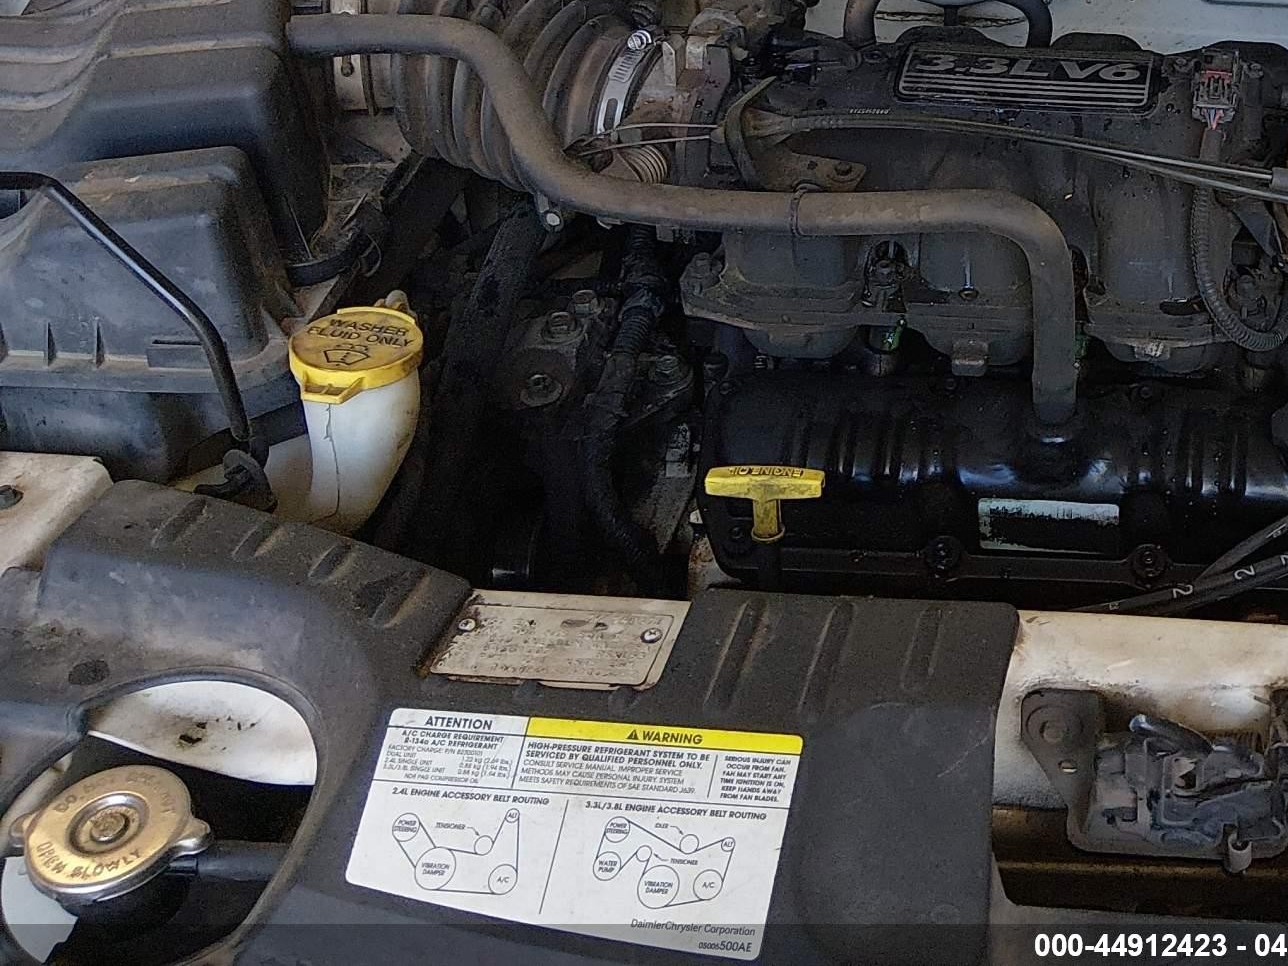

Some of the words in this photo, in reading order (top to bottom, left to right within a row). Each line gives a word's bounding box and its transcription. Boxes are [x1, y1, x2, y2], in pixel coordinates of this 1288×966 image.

[914, 53, 1050, 77] 3.3L
[1060, 60, 1141, 82] V6
[329, 319, 409, 336] WASHER
[307, 326, 360, 340] FLUID
[366, 335, 414, 347] ONLY
[728, 467, 751, 476] OIL
[751, 466, 804, 477] ENGINE
[425, 716, 493, 730] ATTENTION
[404, 737, 428, 745] R-134a
[448, 741, 498, 750] REFRIGERANT
[420, 731, 451, 739] CHARGE
[454, 734, 504, 743] REQUIREMENT
[642, 730, 703, 744] WARNING
[526, 750, 566, 760] SERVICED
[569, 753, 580, 761] BY
[582, 754, 625, 764] QUALIFIED
[628, 757, 678, 767] PERSONNEL
[679, 760, 703, 769] ONLY.
[528, 741, 592, 754] HIGH-PRESSURE
[594, 745, 651, 757] REFRIGERANT
[653, 749, 686, 759] SYSTEM
[688, 752, 698, 760] TO
[700, 753, 710, 761] BE
[521, 768, 553, 776] METHODS
[572, 771, 594, 779] CAUSE
[596, 772, 632, 782] PERSONAL
[659, 777, 684, 785] SYSTEM
[523, 759, 555, 767] CONSULT
[556, 761, 584, 769] SERVICE
[619, 765, 654, 774] IMPROPER
[655, 767, 683, 777] SERVICE
[541, 777, 564, 785] SAFETY
[565, 779, 616, 789] REQUIREMENTS
[642, 784, 678, 793] STANDARD
[738, 786, 760, 794] HANDS
[392, 787, 409, 795] 2.4L
[410, 789, 440, 798] ENGINE
[442, 791, 492, 802] ACCESSORY
[493, 794, 511, 802] BELT
[512, 795, 550, 805] ROUTING
[585, 801, 623, 811] 3.3L/3.8L
[625, 804, 655, 813] ENGINE
[657, 806, 708, 817] ACCESSORY
[729, 811, 767, 821] ROUTING
[702, 881, 716, 889] A/C
[630, 919, 702, 933] DaimlerChrysler
[704, 924, 756, 937] Corporation
